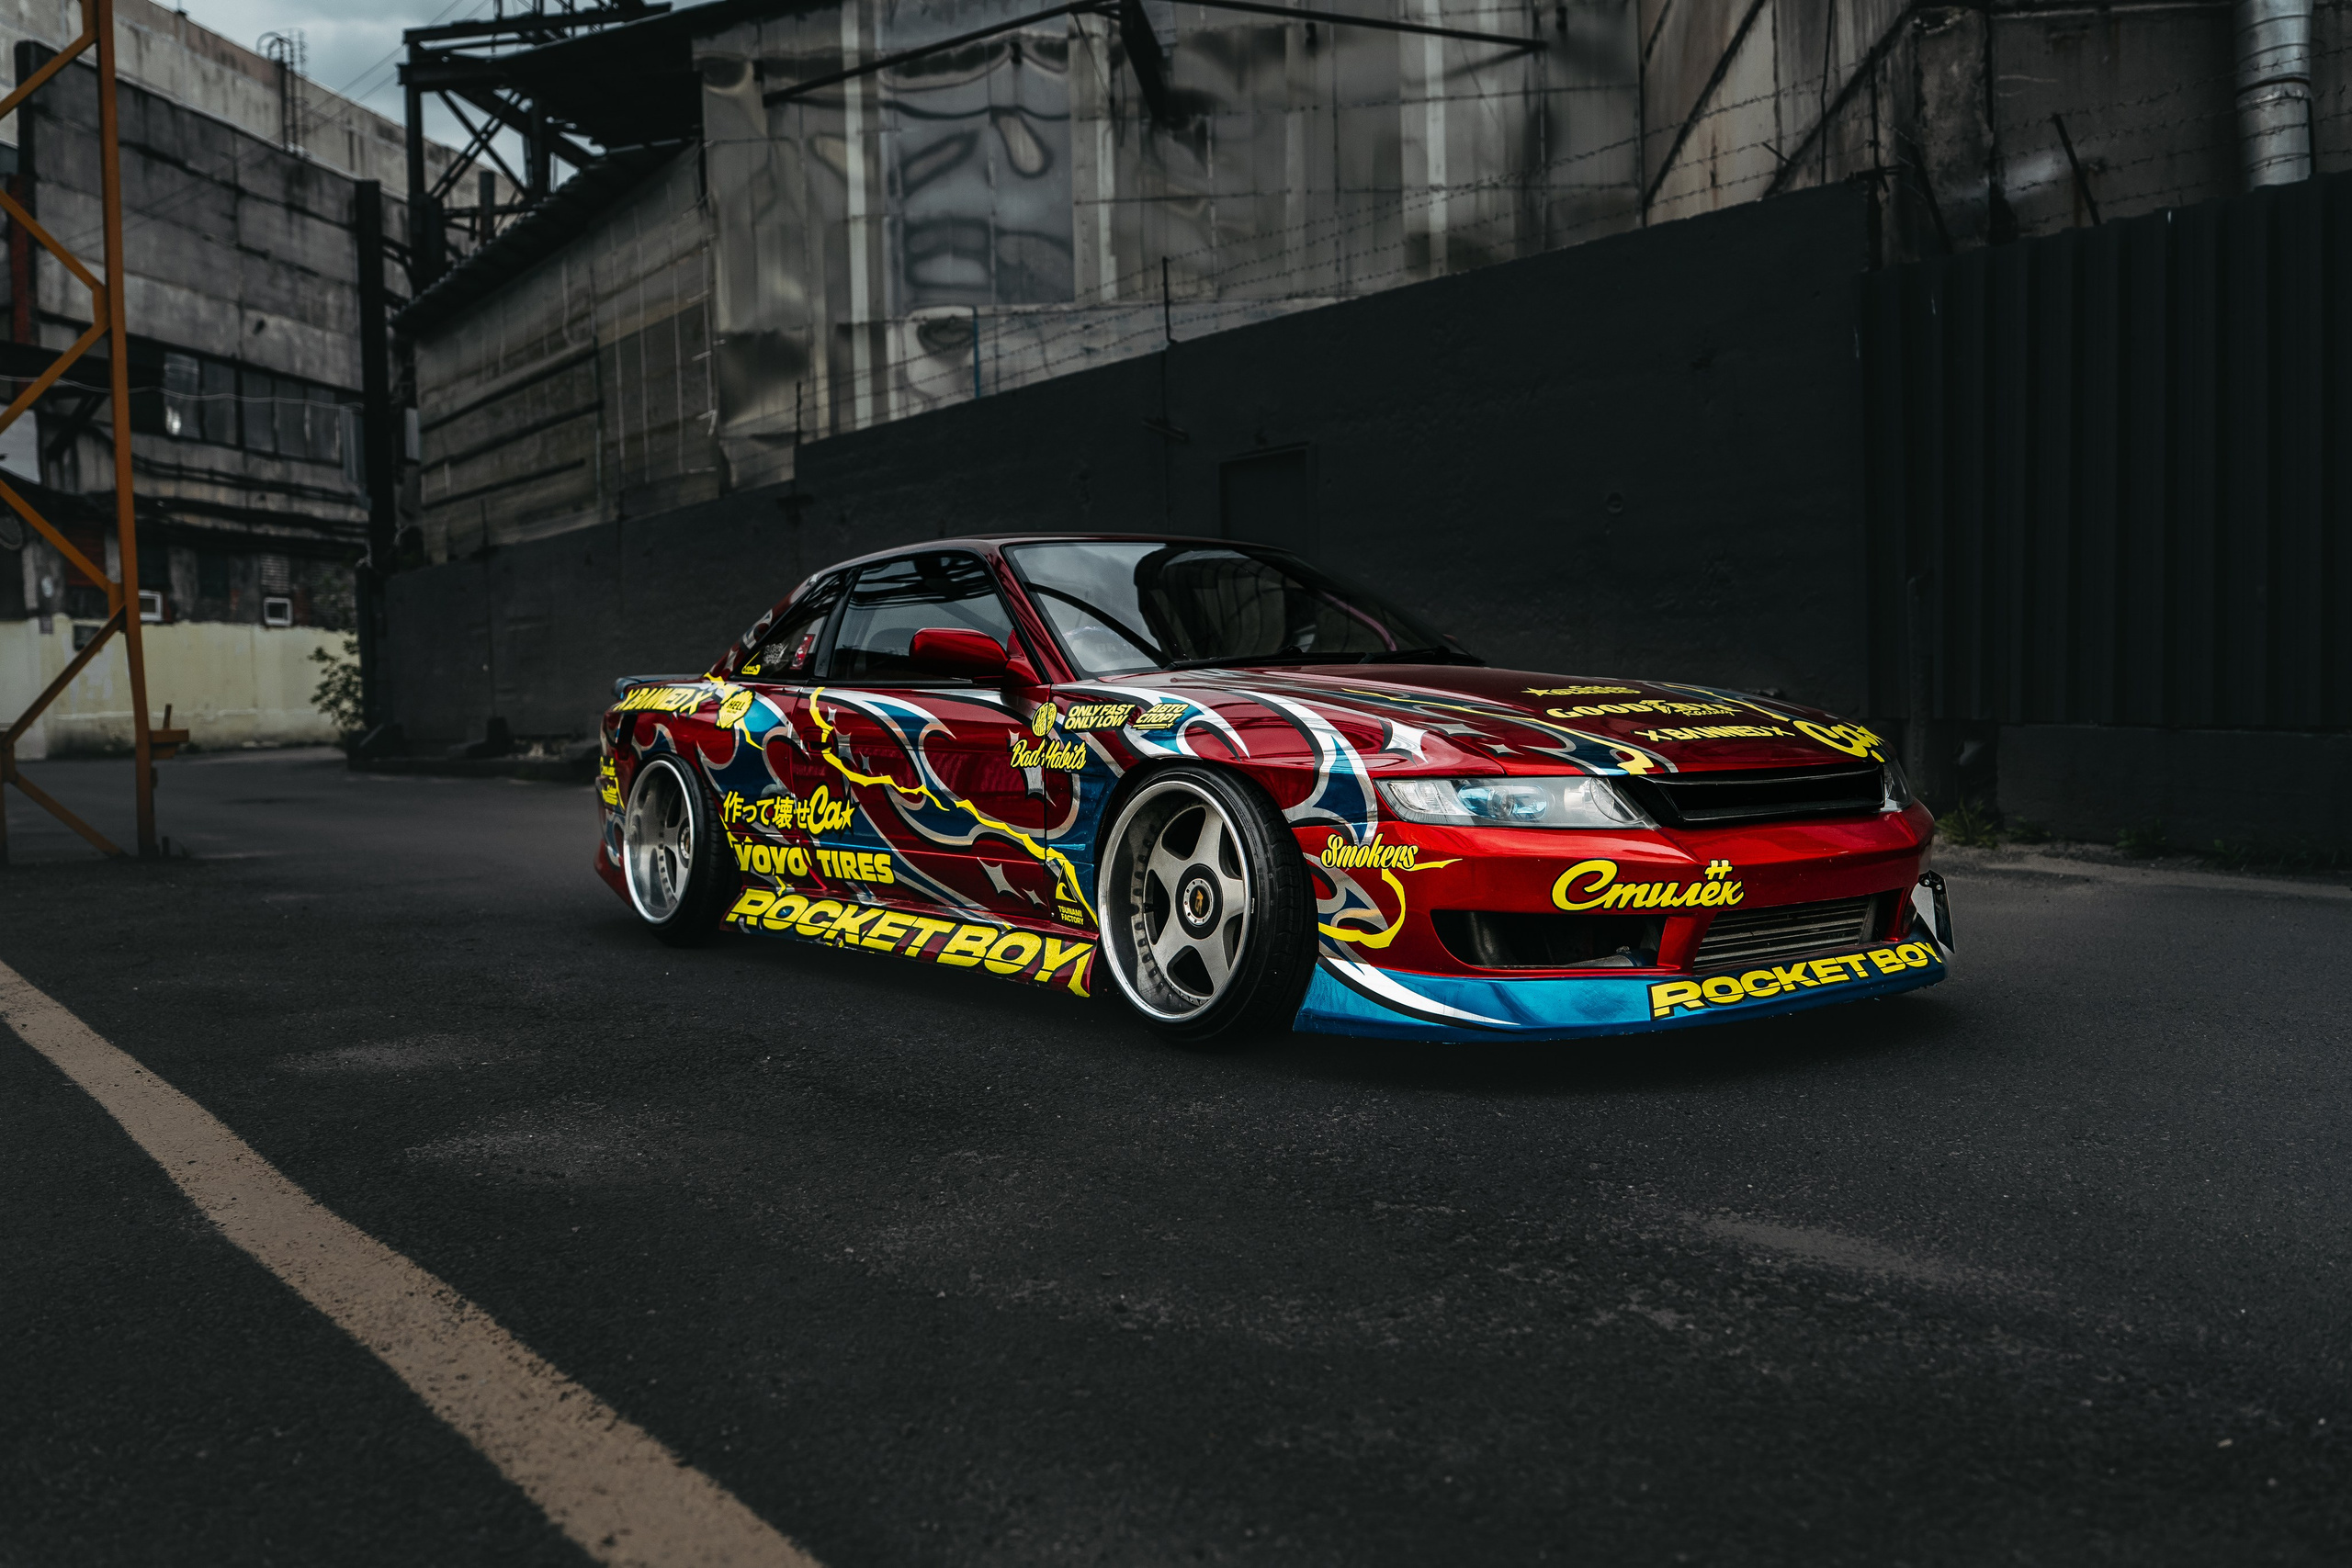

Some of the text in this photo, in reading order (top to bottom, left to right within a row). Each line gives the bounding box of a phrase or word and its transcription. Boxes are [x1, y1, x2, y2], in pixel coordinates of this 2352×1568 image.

[1069, 705, 1136, 717] ONLY FAST
[1148, 704, 1189, 714] АВТО
[1547, 704, 1653, 717] GOOD
[1065, 716, 1128, 730] ONLY LOW
[1136, 713, 1182, 724] СПОРТ
[1011, 739, 1086, 770] Bad Habits
[1321, 833, 1419, 868] Smokers
[734, 844, 895, 885] YOYO TIRES
[1553, 859, 1744, 909] Стилёк
[1057, 905, 1082, 918] TSUNAMI
[1061, 913, 1083, 925] FACTORY
